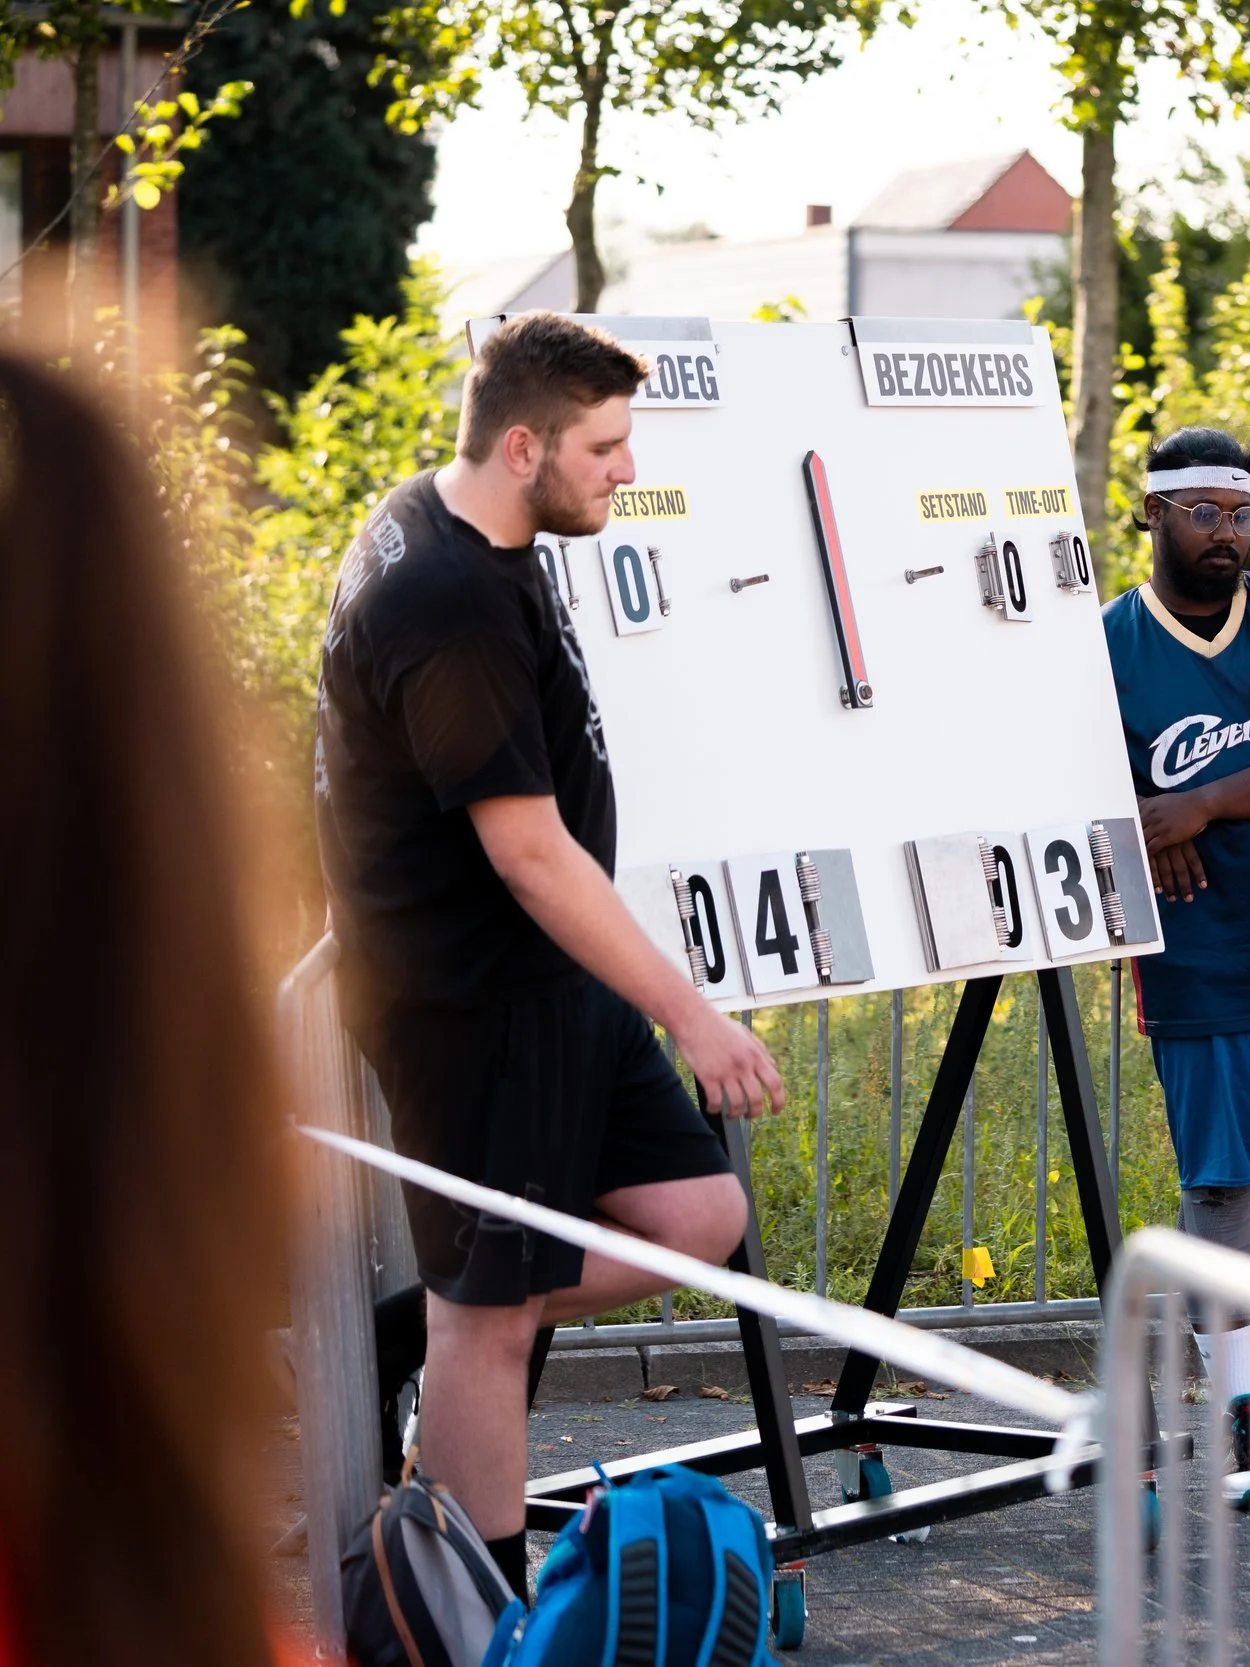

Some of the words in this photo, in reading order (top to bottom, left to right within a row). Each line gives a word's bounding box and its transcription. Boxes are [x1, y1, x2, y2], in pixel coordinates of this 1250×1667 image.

[873, 352, 1034, 398] BEZOEKERS
[611, 489, 687, 517] SETSTAND
[920, 491, 988, 519] SETSTAND
[1005, 488, 1068, 516] TIME-OUT
[613, 544, 651, 623] 0
[1002, 540, 1028, 613] 0
[1072, 535, 1091, 586] 0
